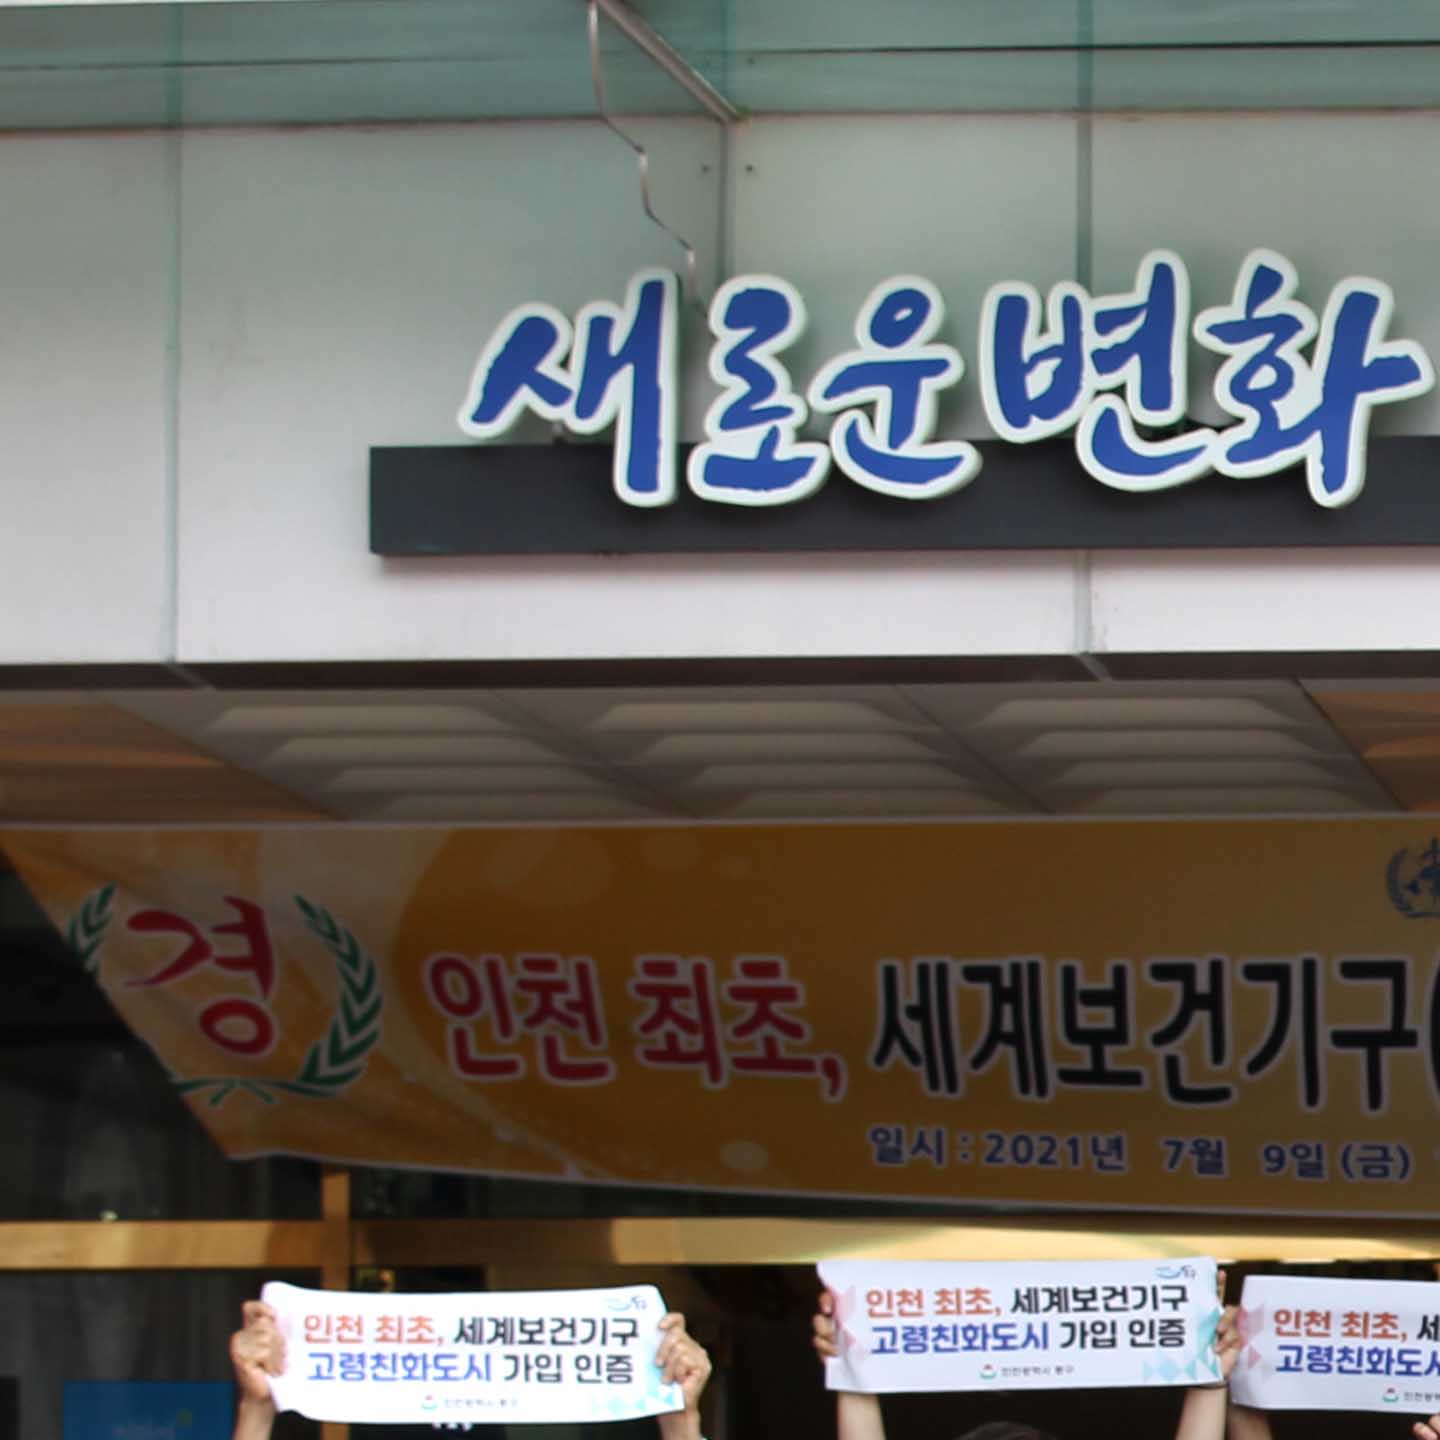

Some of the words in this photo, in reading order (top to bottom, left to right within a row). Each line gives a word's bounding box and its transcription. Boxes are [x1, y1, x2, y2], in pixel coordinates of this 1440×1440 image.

[126, 896, 275, 1056] 경
[428, 954, 609, 1082] 인천
[632, 957, 844, 1098] 최초,
[983, 1130, 1127, 1173] 2021년
[1161, 1138, 1227, 1176] 7월
[866, 1289, 924, 1318] 인천
[935, 1288, 1001, 1316] 최초,
[1010, 1284, 1189, 1315] 세계보건기구
[305, 1315, 362, 1344] 인천
[376, 1316, 443, 1345] 최초,
[453, 1317, 639, 1347] 세계보건기구
[871, 1321, 1049, 1355] 고령친화도시
[1059, 1320, 1117, 1350] 가입
[1127, 1318, 1186, 1348] 인증
[308, 1352, 491, 1382] 고령친화도시
[503, 1353, 562, 1383] 가입
[574, 1354, 633, 1384] 인증
